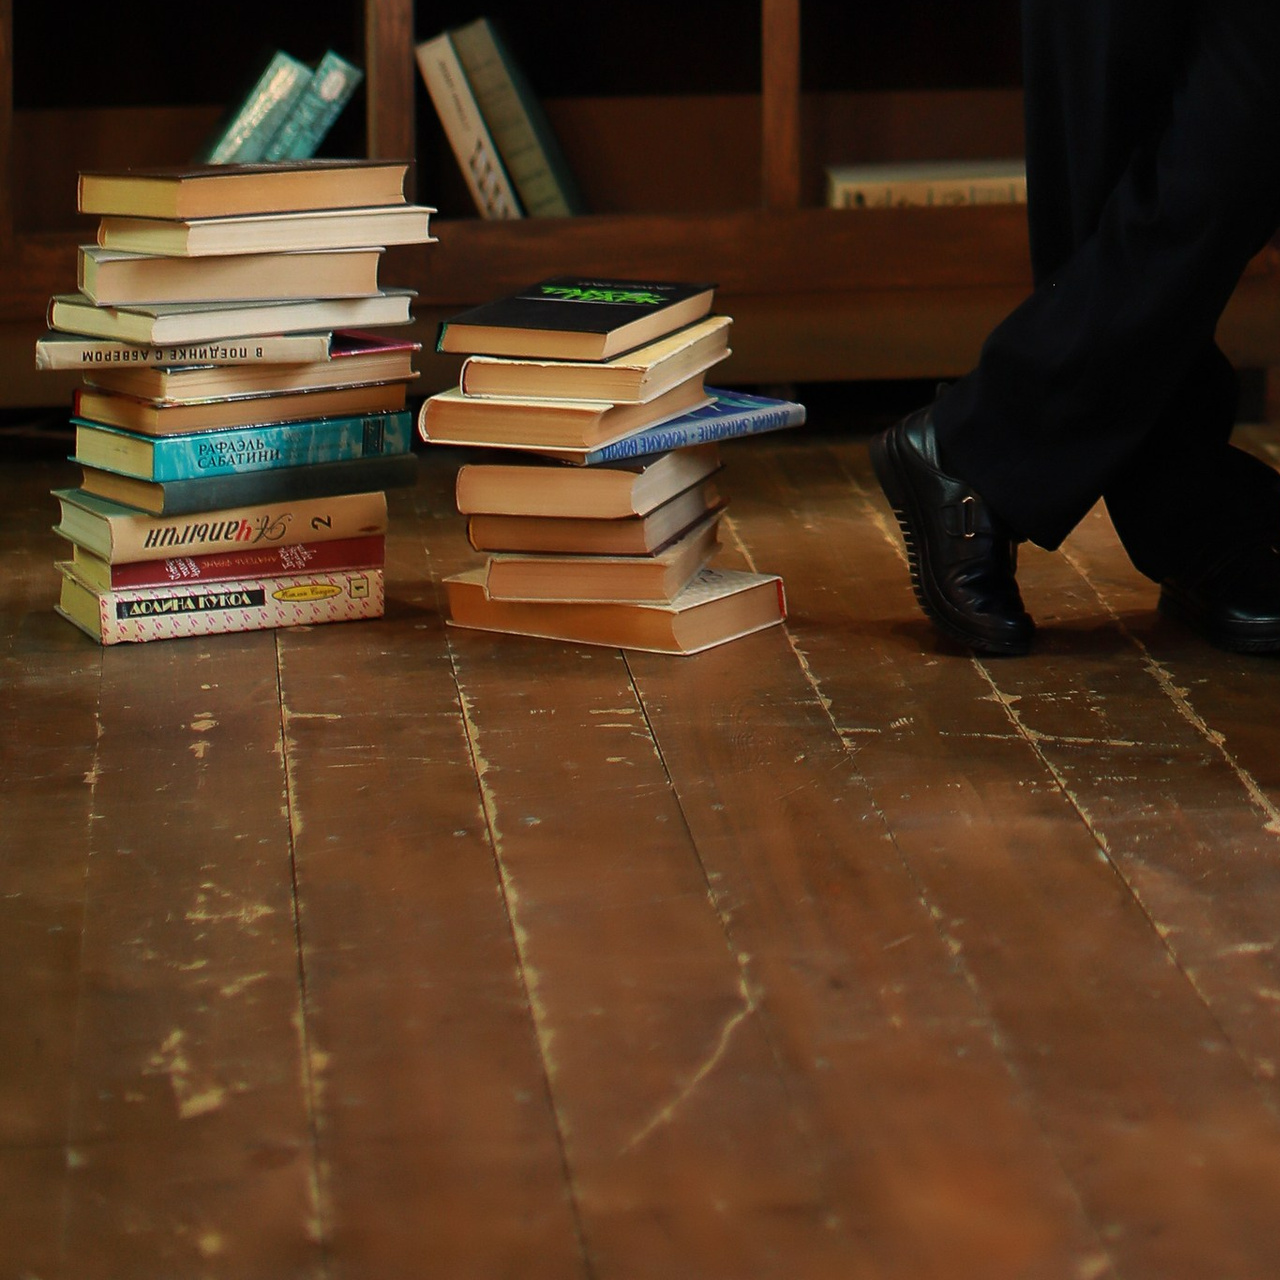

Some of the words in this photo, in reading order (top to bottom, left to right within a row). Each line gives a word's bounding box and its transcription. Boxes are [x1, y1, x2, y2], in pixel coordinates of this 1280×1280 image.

[81, 349, 149, 362] АБВЕРОМ
[155, 349, 163, 361] С
[169, 345, 247, 360] ПОЕДИНКЕ
[255, 347, 263, 358] В
[198, 436, 265, 456] РАФАЭЛЬ
[197, 447, 281, 470] САБАТИНИ
[144, 518, 253, 549] Чапыгин
[128, 596, 196, 616] ДОЛИНА
[197, 591, 253, 610] КУКОЛ
